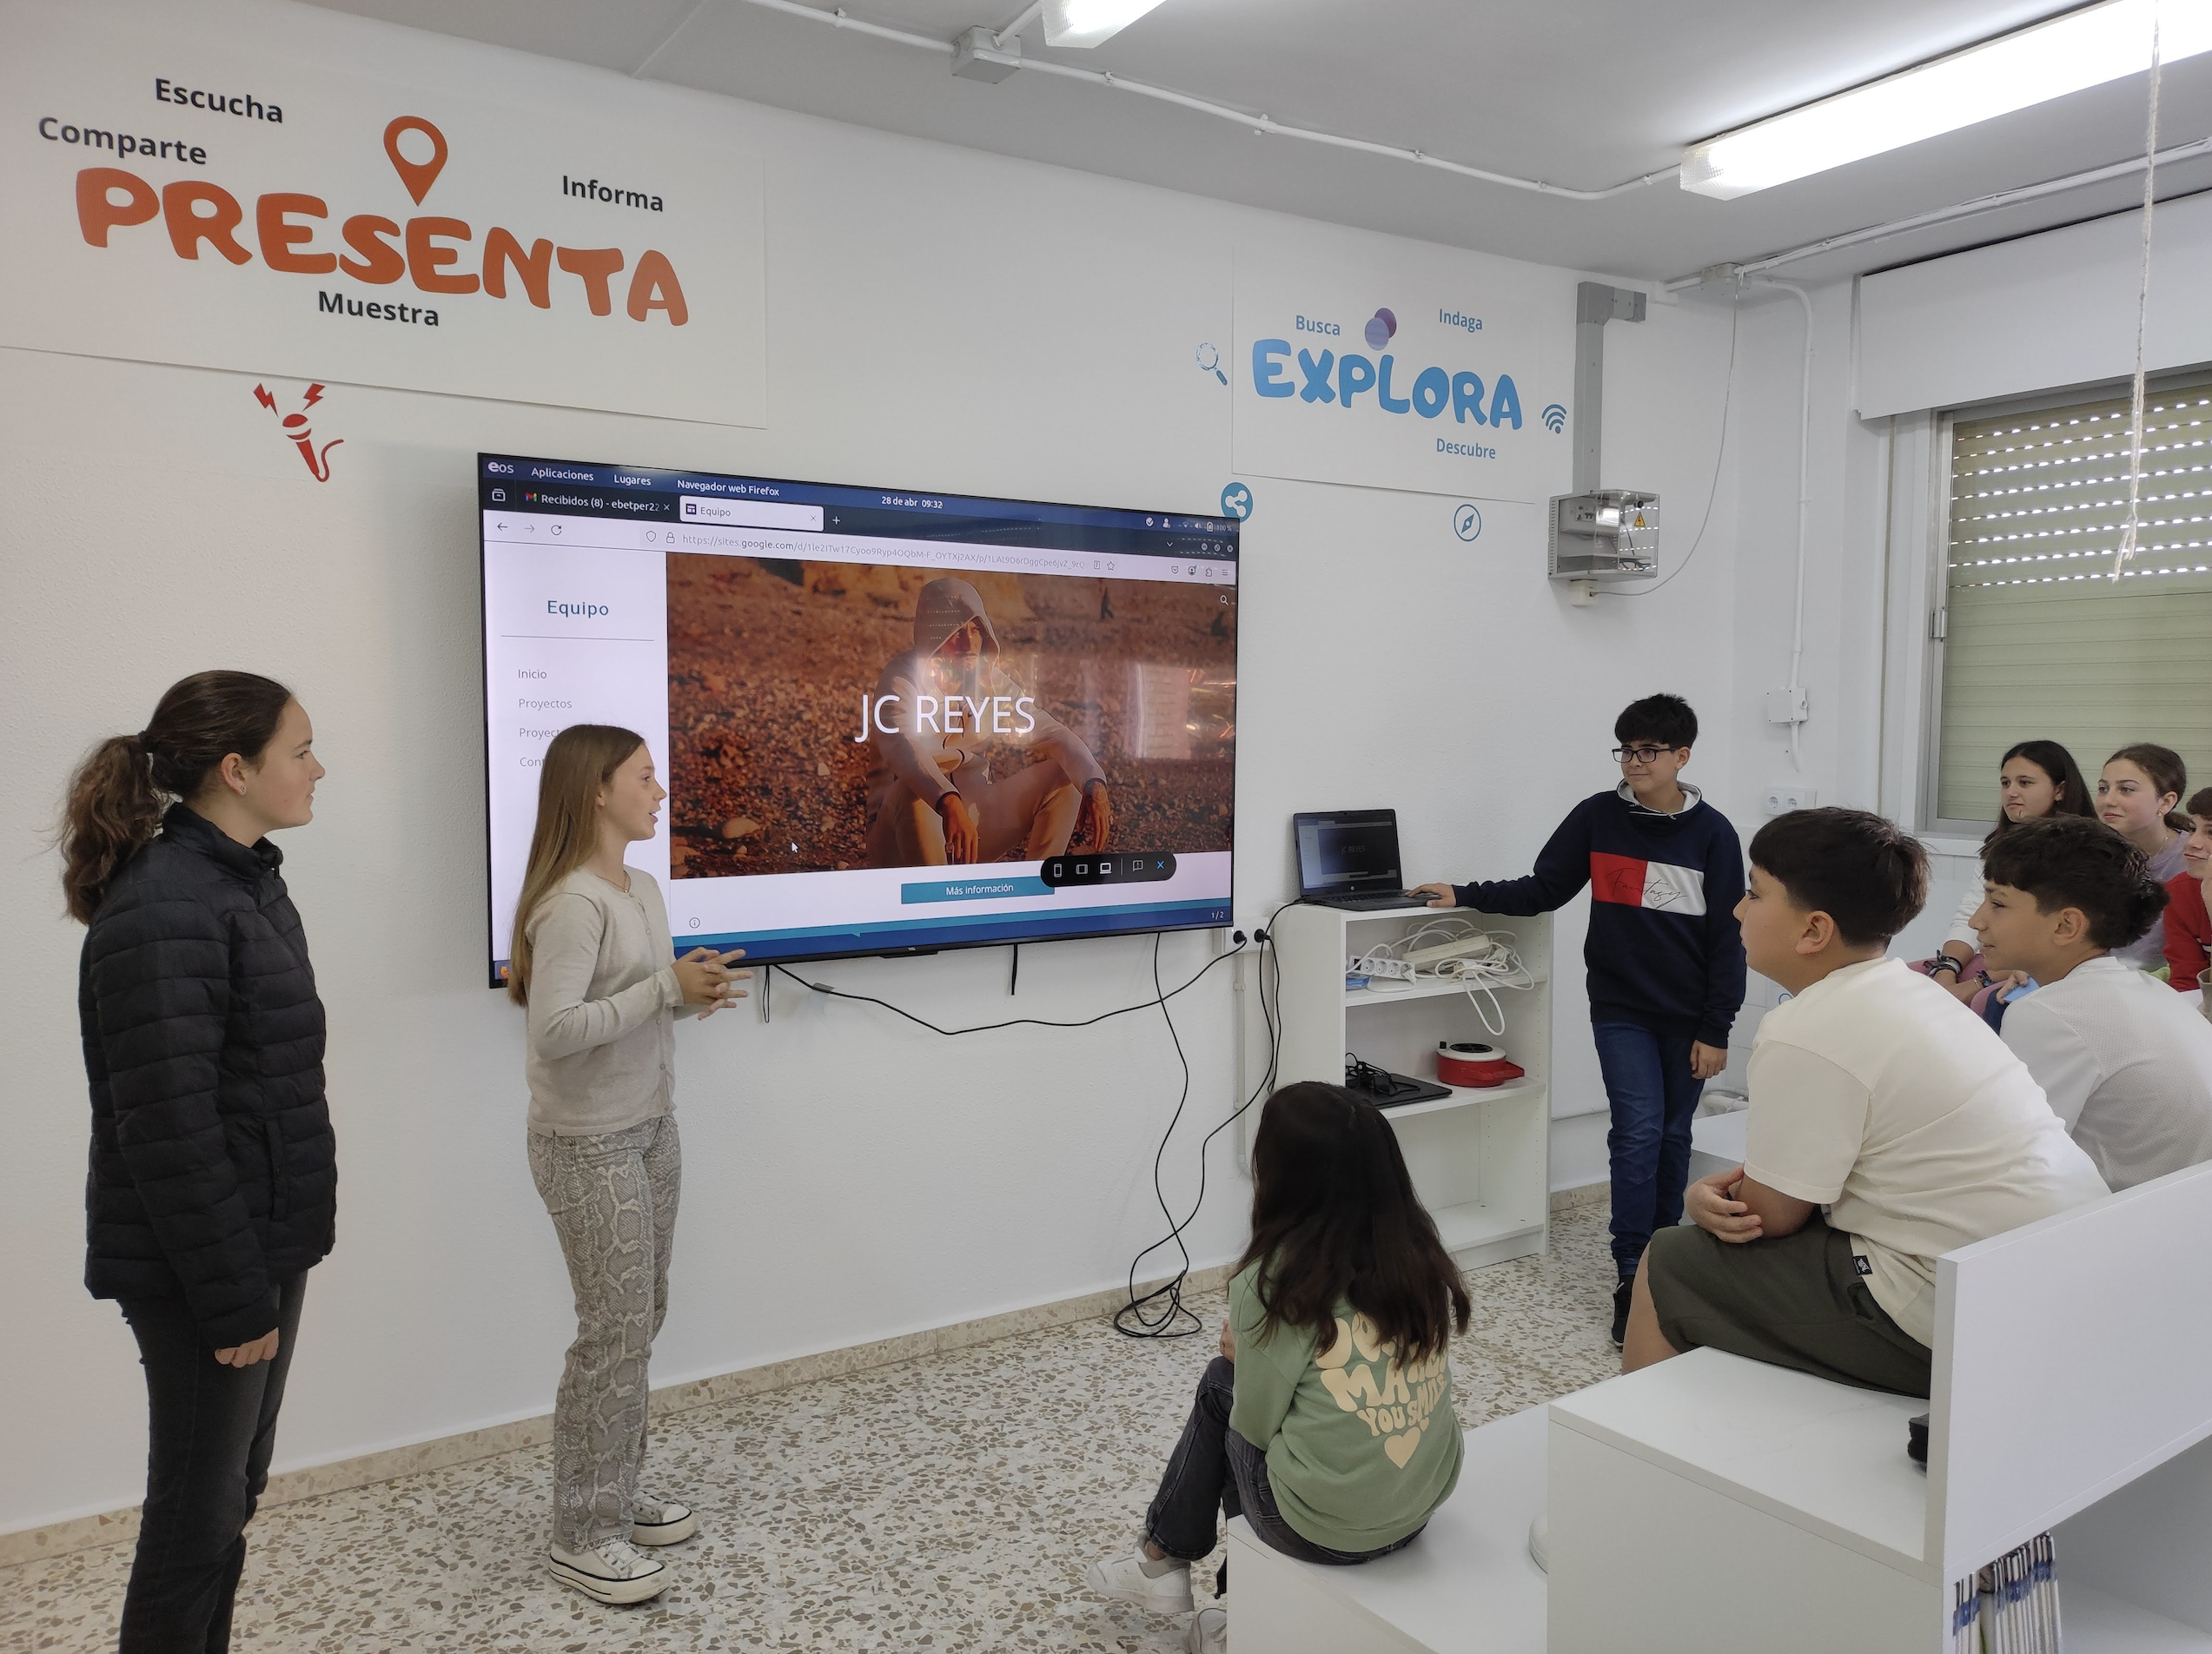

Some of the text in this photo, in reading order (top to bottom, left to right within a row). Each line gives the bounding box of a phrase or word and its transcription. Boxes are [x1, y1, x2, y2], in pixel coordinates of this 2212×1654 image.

[156, 78, 284, 123] Escucha
[38, 116, 208, 165] Comparte
[562, 175, 664, 213] Informa
[76, 167, 689, 327] PRESENTA
[318, 290, 440, 327] Muestra
[1295, 315, 1341, 336] Busca
[1439, 308, 1483, 333] Indaga
[1253, 339, 1522, 430] EXPLORA
[1436, 438, 1496, 460] Descubre
[487, 461, 514, 474] eos
[531, 467, 594, 481] Aplicaciones
[613, 474, 652, 486] Lugares
[677, 480, 780, 497] Navegador web Firefox
[541, 494, 589, 506] Recibidos
[591, 498, 604, 509] (8)
[881, 496, 944, 509] 28 de abr 09:32
[700, 507, 732, 518] Equipo
[547, 599, 609, 619] Equipo
[518, 669, 547, 679] Inicio
[519, 698, 573, 711] Proyectos
[854, 694, 1036, 744] JC REYES
[945, 885, 964, 896] Más
[1210, 910, 1224, 921] 1/2
[1356, 1373, 1447, 1437] YOU SMILE
